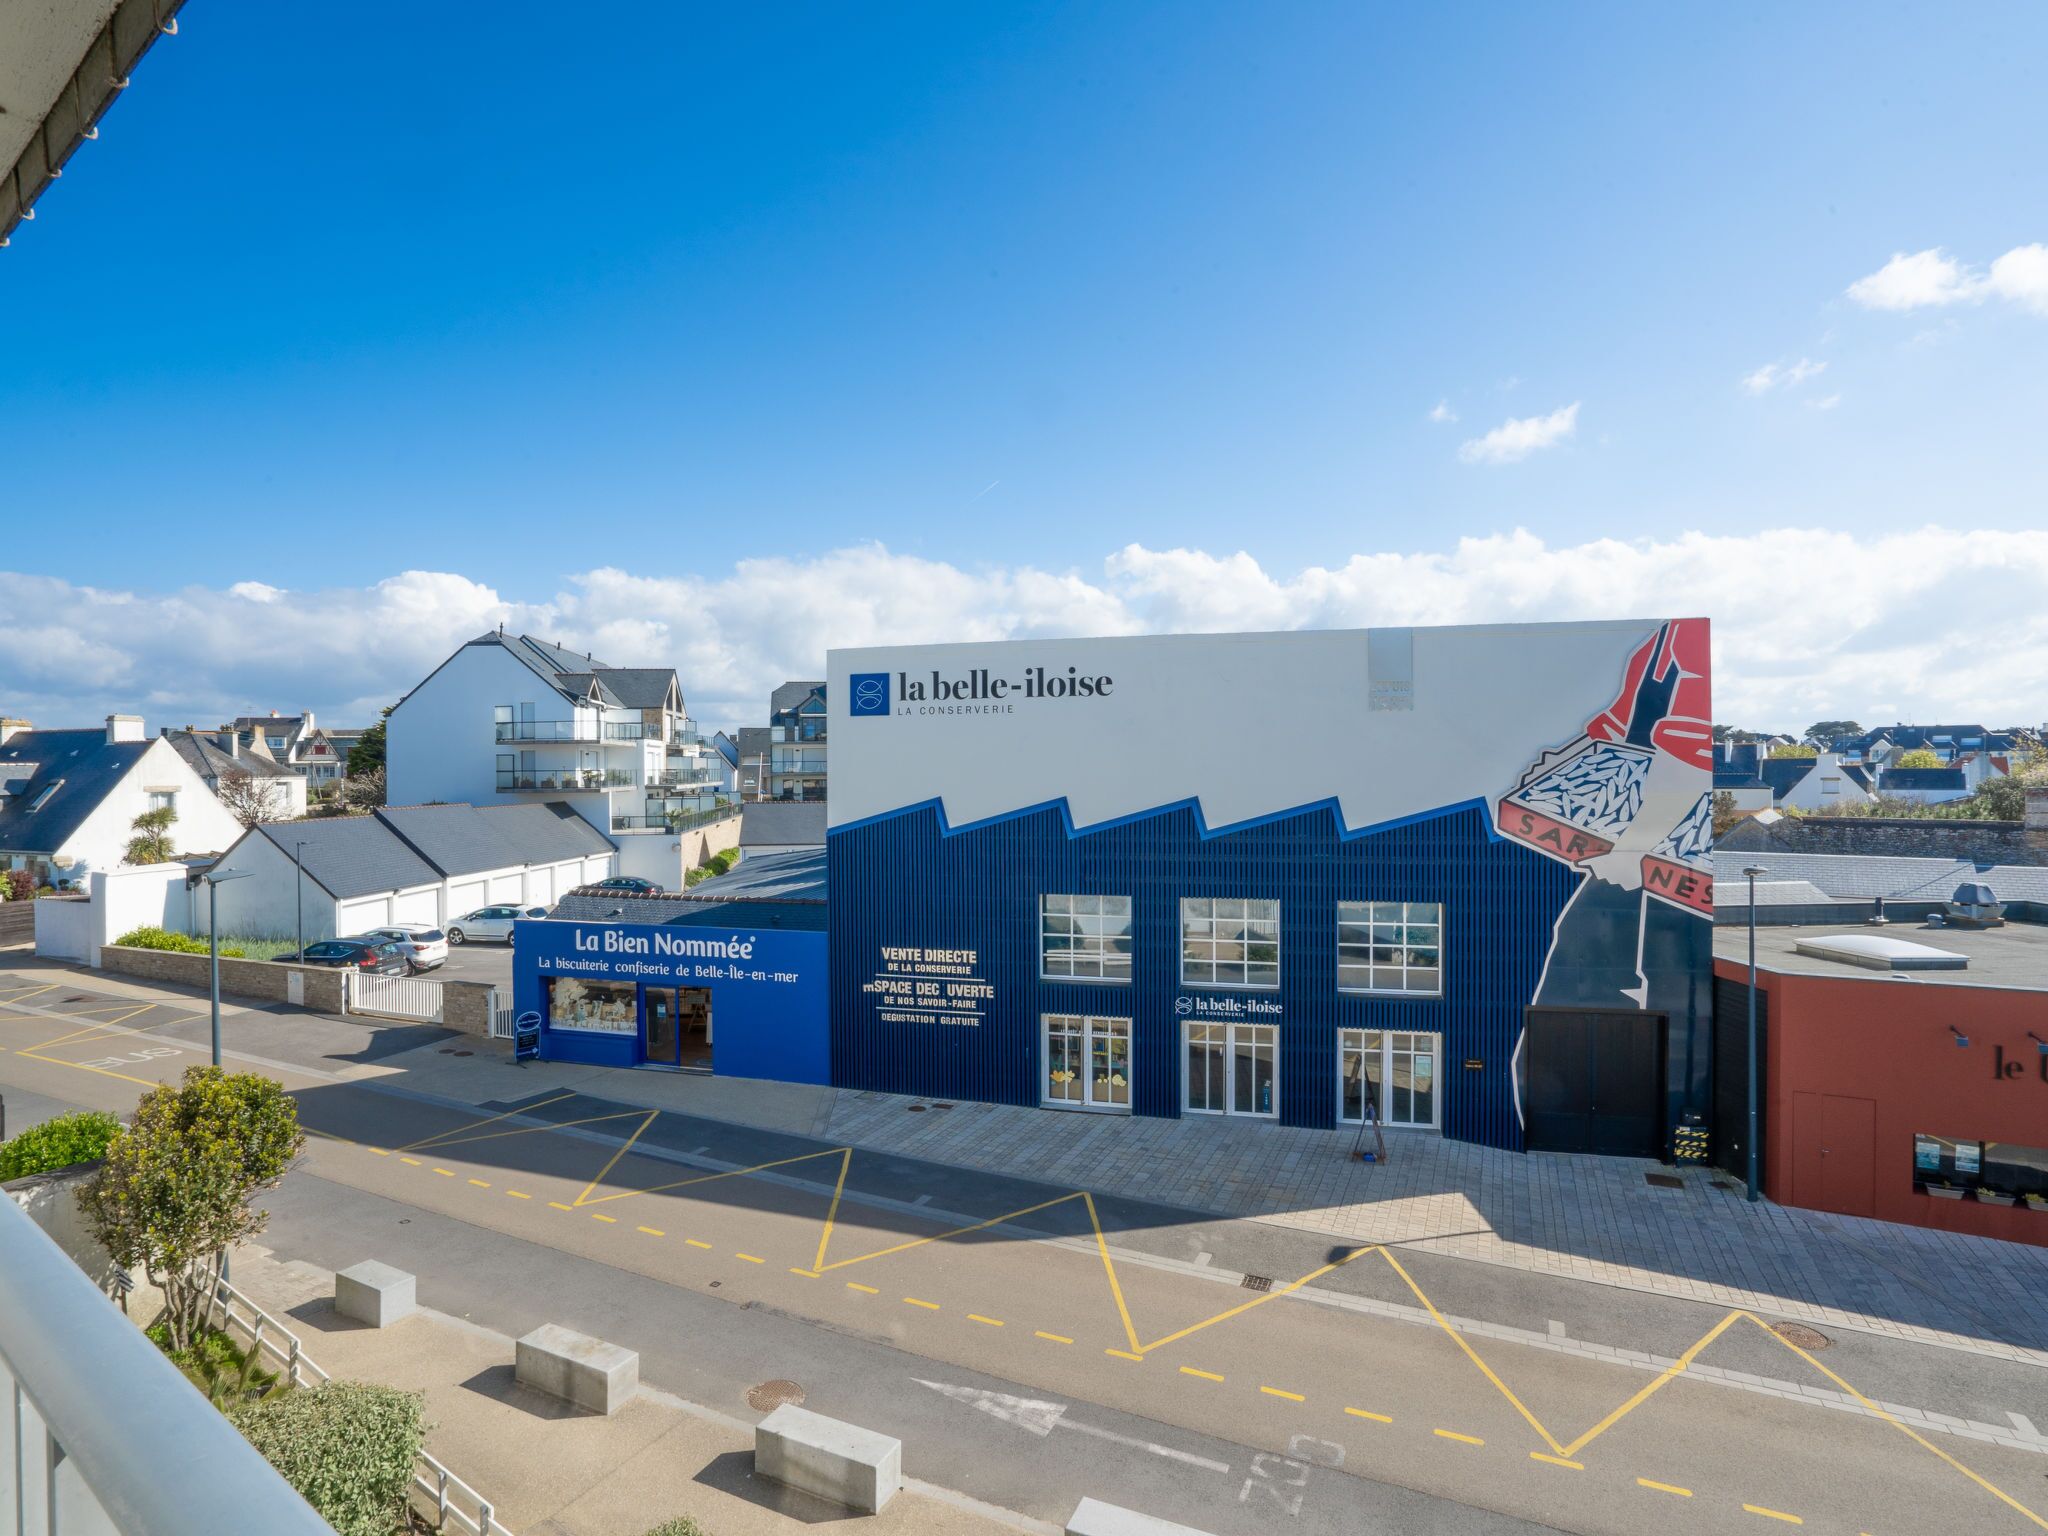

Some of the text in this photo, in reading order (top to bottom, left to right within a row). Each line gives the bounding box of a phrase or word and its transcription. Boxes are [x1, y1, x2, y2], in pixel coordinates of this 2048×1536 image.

[897, 666, 1113, 701] la belle-iloise
[897, 704, 1014, 715] LA CONSERVERIE
[575, 928, 598, 951] La
[604, 930, 648, 953] Bien
[881, 947, 976, 964] VENTE DIRECTE
[538, 956, 550, 967] La
[555, 956, 608, 971] biscuiterie
[615, 960, 669, 975] confiserie
[675, 963, 689, 976] de
[887, 962, 971, 974] DE LA CONSERVERIE
[883, 995, 976, 1008] DE NOS SAVOIR-FAIRE
[1195, 997, 1282, 1013] la belle-iloise
[881, 1012, 979, 1026] DEGUSTATION GRATUITE
[76, 1047, 183, 1070] BUS
[1992, 1044, 2025, 1080] le
